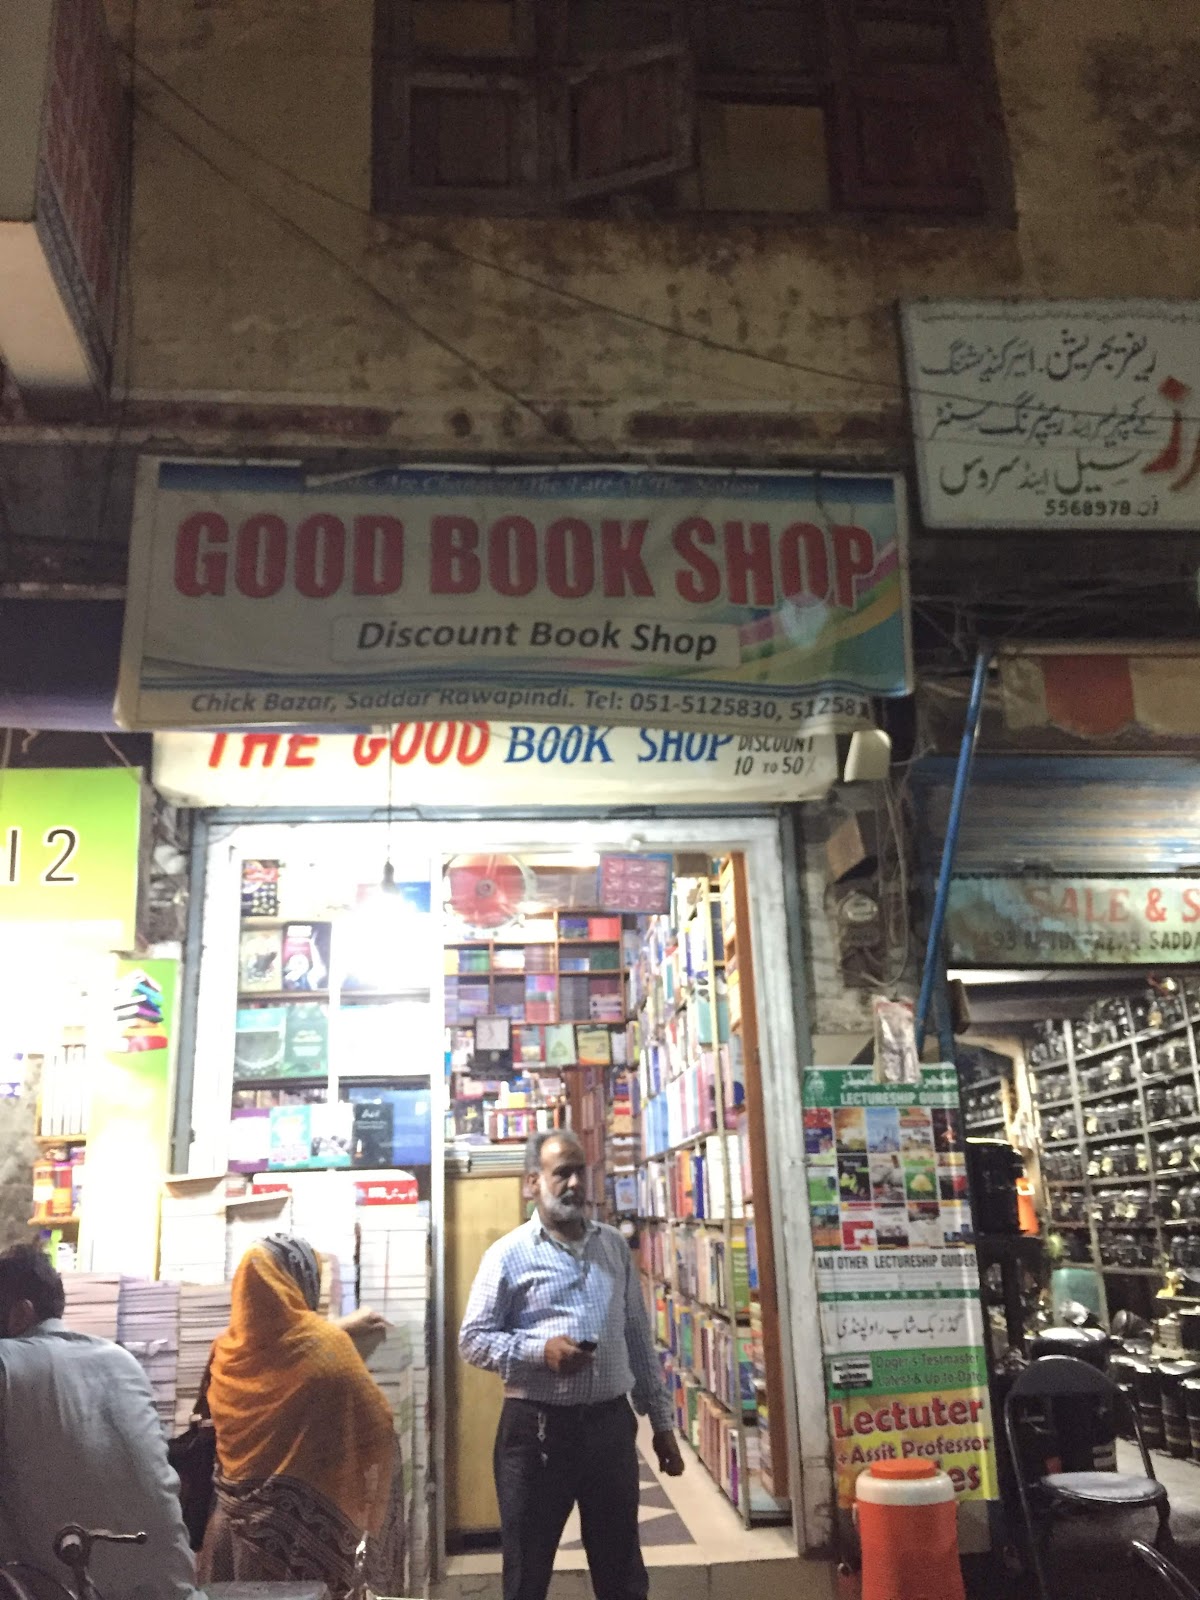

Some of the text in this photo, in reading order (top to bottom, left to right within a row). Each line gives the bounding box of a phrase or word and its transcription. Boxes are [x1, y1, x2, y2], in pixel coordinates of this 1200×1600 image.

[174, 511, 874, 608] GOOD BOOK SHOP
[357, 621, 717, 660] Discount Book Shop
[191, 693, 257, 713] Chick
[263, 692, 337, 713] Bazar,
[345, 689, 431, 710] Saddar
[584, 690, 622, 710] Tel:
[630, 692, 783, 722] 051-5125830,
[354, 720, 490, 766] GOOD
[504, 725, 614, 764] BOOK
[637, 727, 733, 763] SHOP
[738, 735, 815, 753] DISCOUNT
[735, 756, 753, 776] 10
[763, 762, 778, 773] TO
[1024, 887, 1130, 922] SALE
[1145, 887, 1168, 922] &
[817, 1253, 976, 1270] AND OTHER LECTURESHIP GUIDES
[902, 1436, 990, 1459] Professor
